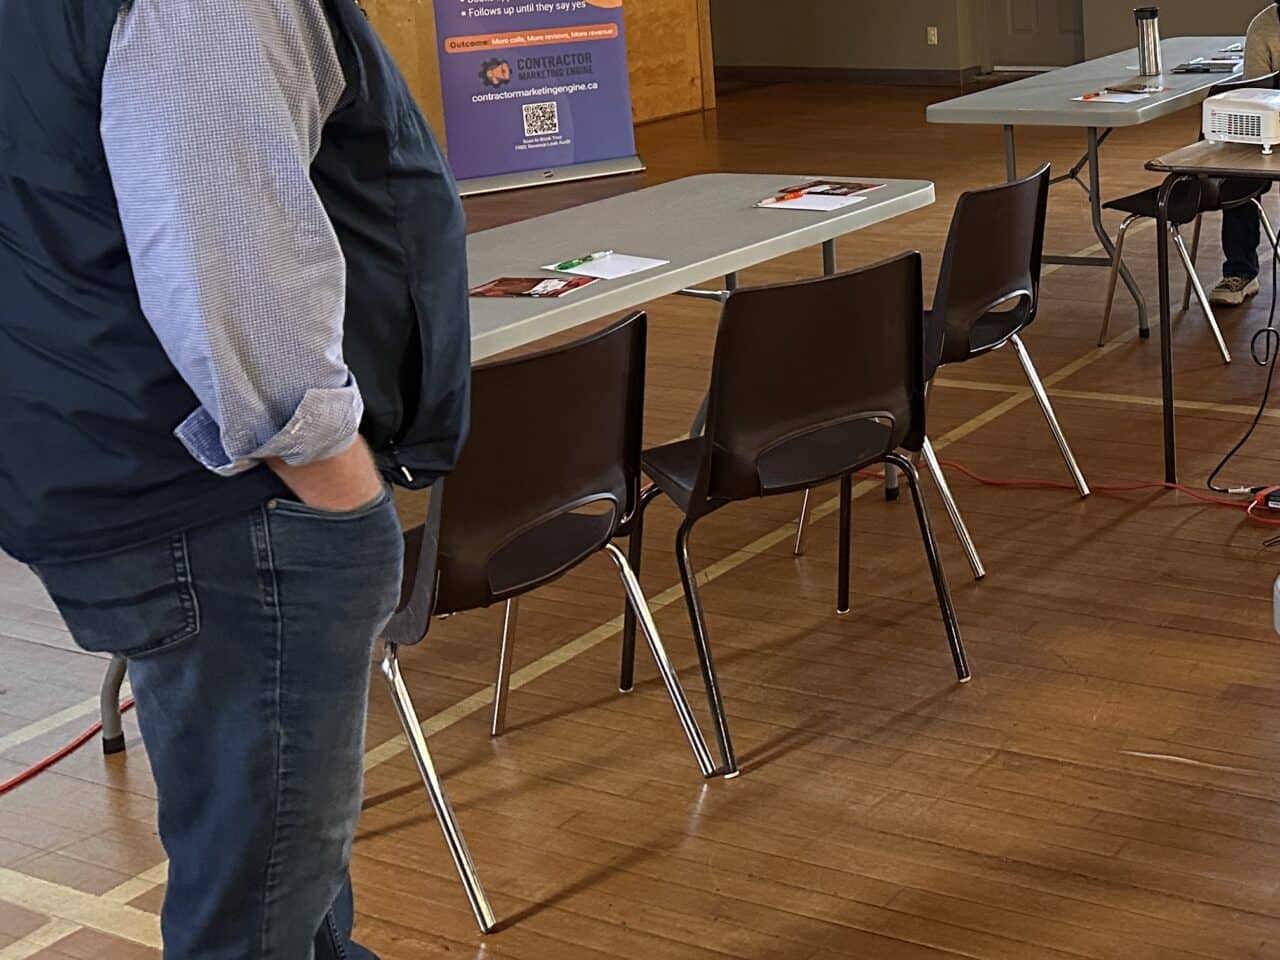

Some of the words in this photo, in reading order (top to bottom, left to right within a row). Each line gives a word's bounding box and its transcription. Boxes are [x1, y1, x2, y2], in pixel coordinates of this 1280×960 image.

[468, 8, 502, 17] Follows
[503, 7, 515, 16] up
[516, 5, 534, 13] until
[536, 3, 554, 12] they
[555, 1, 570, 10] say
[571, 0, 587, 9] yes
[517, 53, 592, 70] CONTRACTOR
[518, 69, 564, 80] MARKETING
[471, 81, 598, 103] contractormarketingengine.ca
